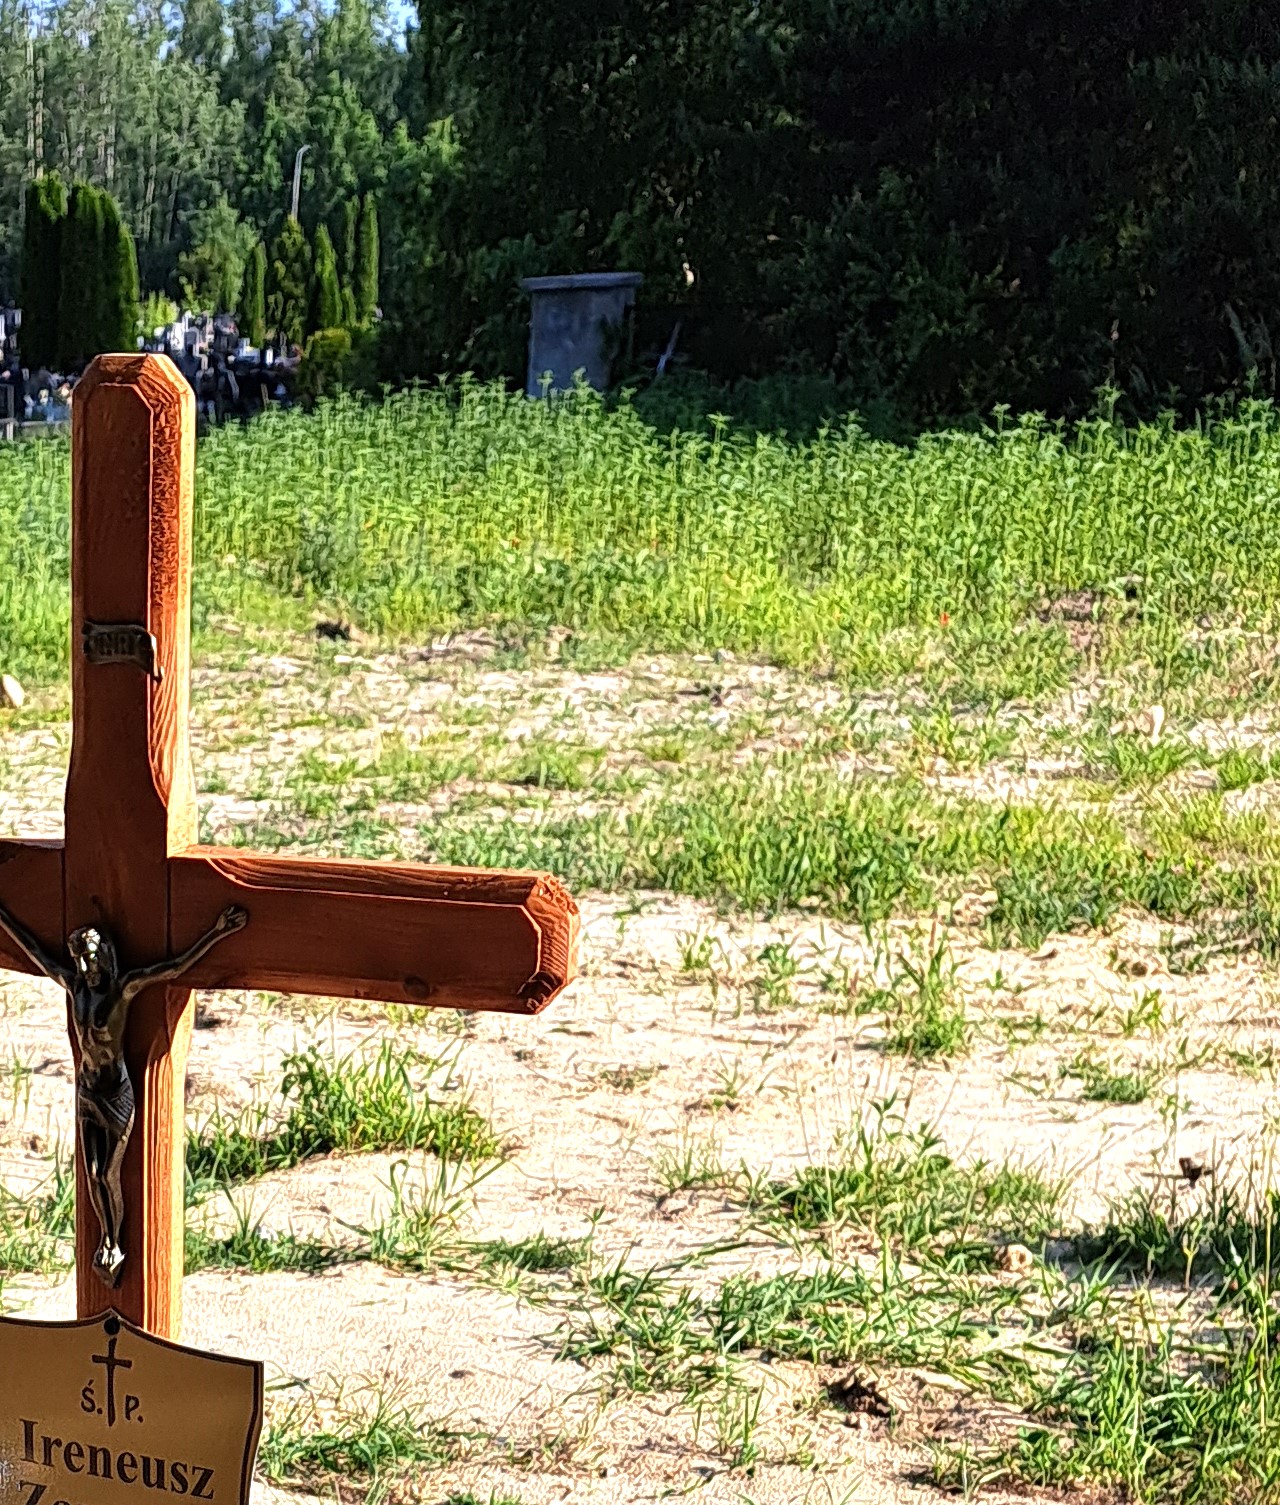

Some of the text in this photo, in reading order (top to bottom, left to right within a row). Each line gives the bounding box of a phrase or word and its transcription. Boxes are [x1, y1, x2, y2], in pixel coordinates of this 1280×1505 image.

[81, 1380, 145, 1423] Ś. P.
[20, 1418, 214, 1500] Ireneusz
